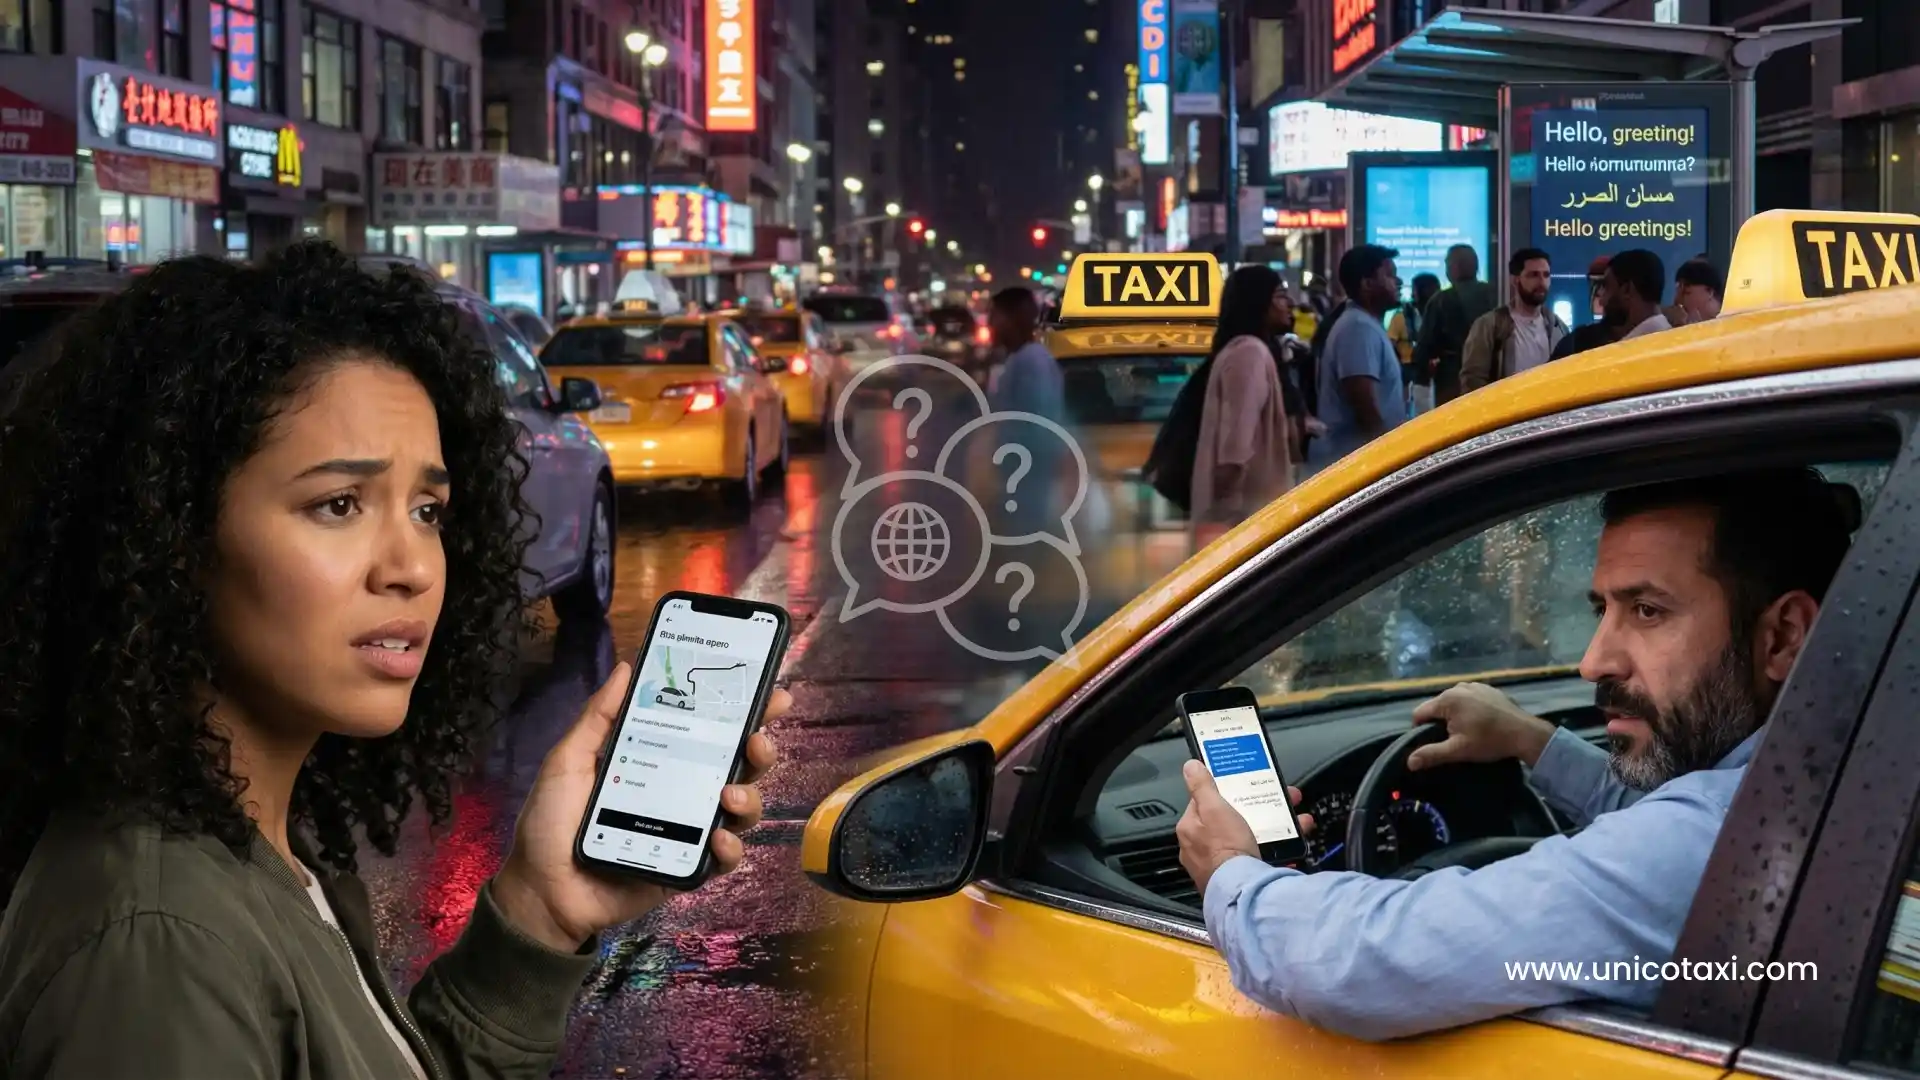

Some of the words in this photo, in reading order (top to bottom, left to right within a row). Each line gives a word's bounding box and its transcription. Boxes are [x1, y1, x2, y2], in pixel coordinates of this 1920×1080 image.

[1545, 120, 1608, 145] Hello,
[1612, 124, 1695, 146] greeting!
[1545, 156, 1586, 172] Hello
[1545, 218, 1594, 237] Hello
[1598, 218, 1692, 241] greetings!
[1805, 229, 1920, 289] TAXI
[1092, 265, 1200, 302] TAXI
